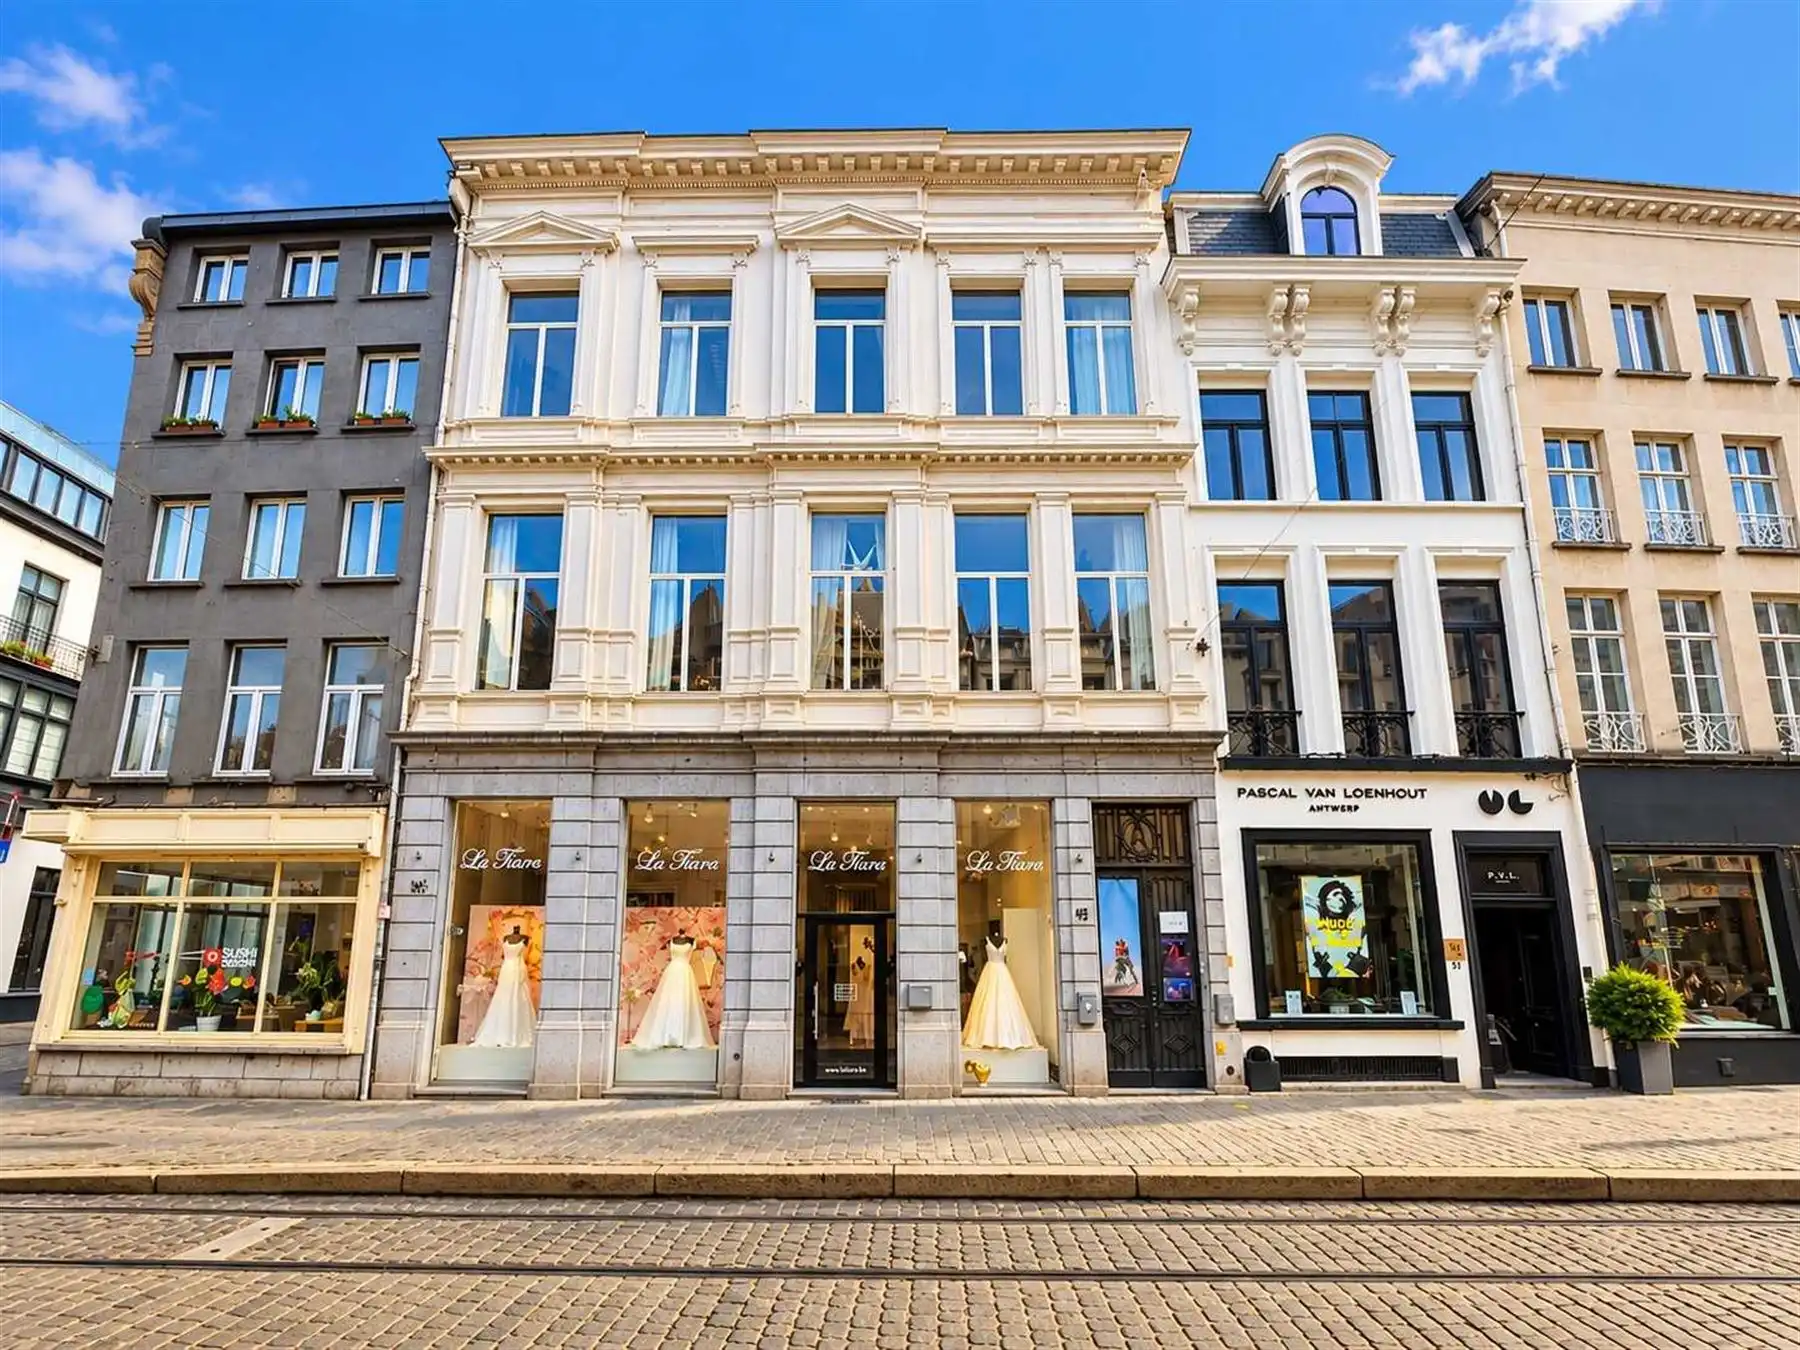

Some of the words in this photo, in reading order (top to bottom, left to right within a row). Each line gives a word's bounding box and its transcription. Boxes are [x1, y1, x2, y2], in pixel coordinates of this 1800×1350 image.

[1236, 787, 1297, 799] PASCAL
[1304, 787, 1337, 799] VAN
[1342, 787, 1428, 800] LOENHOUT
[1308, 804, 1360, 813] ANTWERP
[460, 847, 489, 871] La
[492, 846, 542, 870] Tiara
[635, 849, 666, 871] La
[668, 848, 720, 871] Tiara
[808, 850, 837, 871] La
[840, 850, 886, 871] Tiara
[965, 850, 993, 873] La
[995, 850, 1044, 872] Tiara
[222, 947, 258, 959] SUSHI
